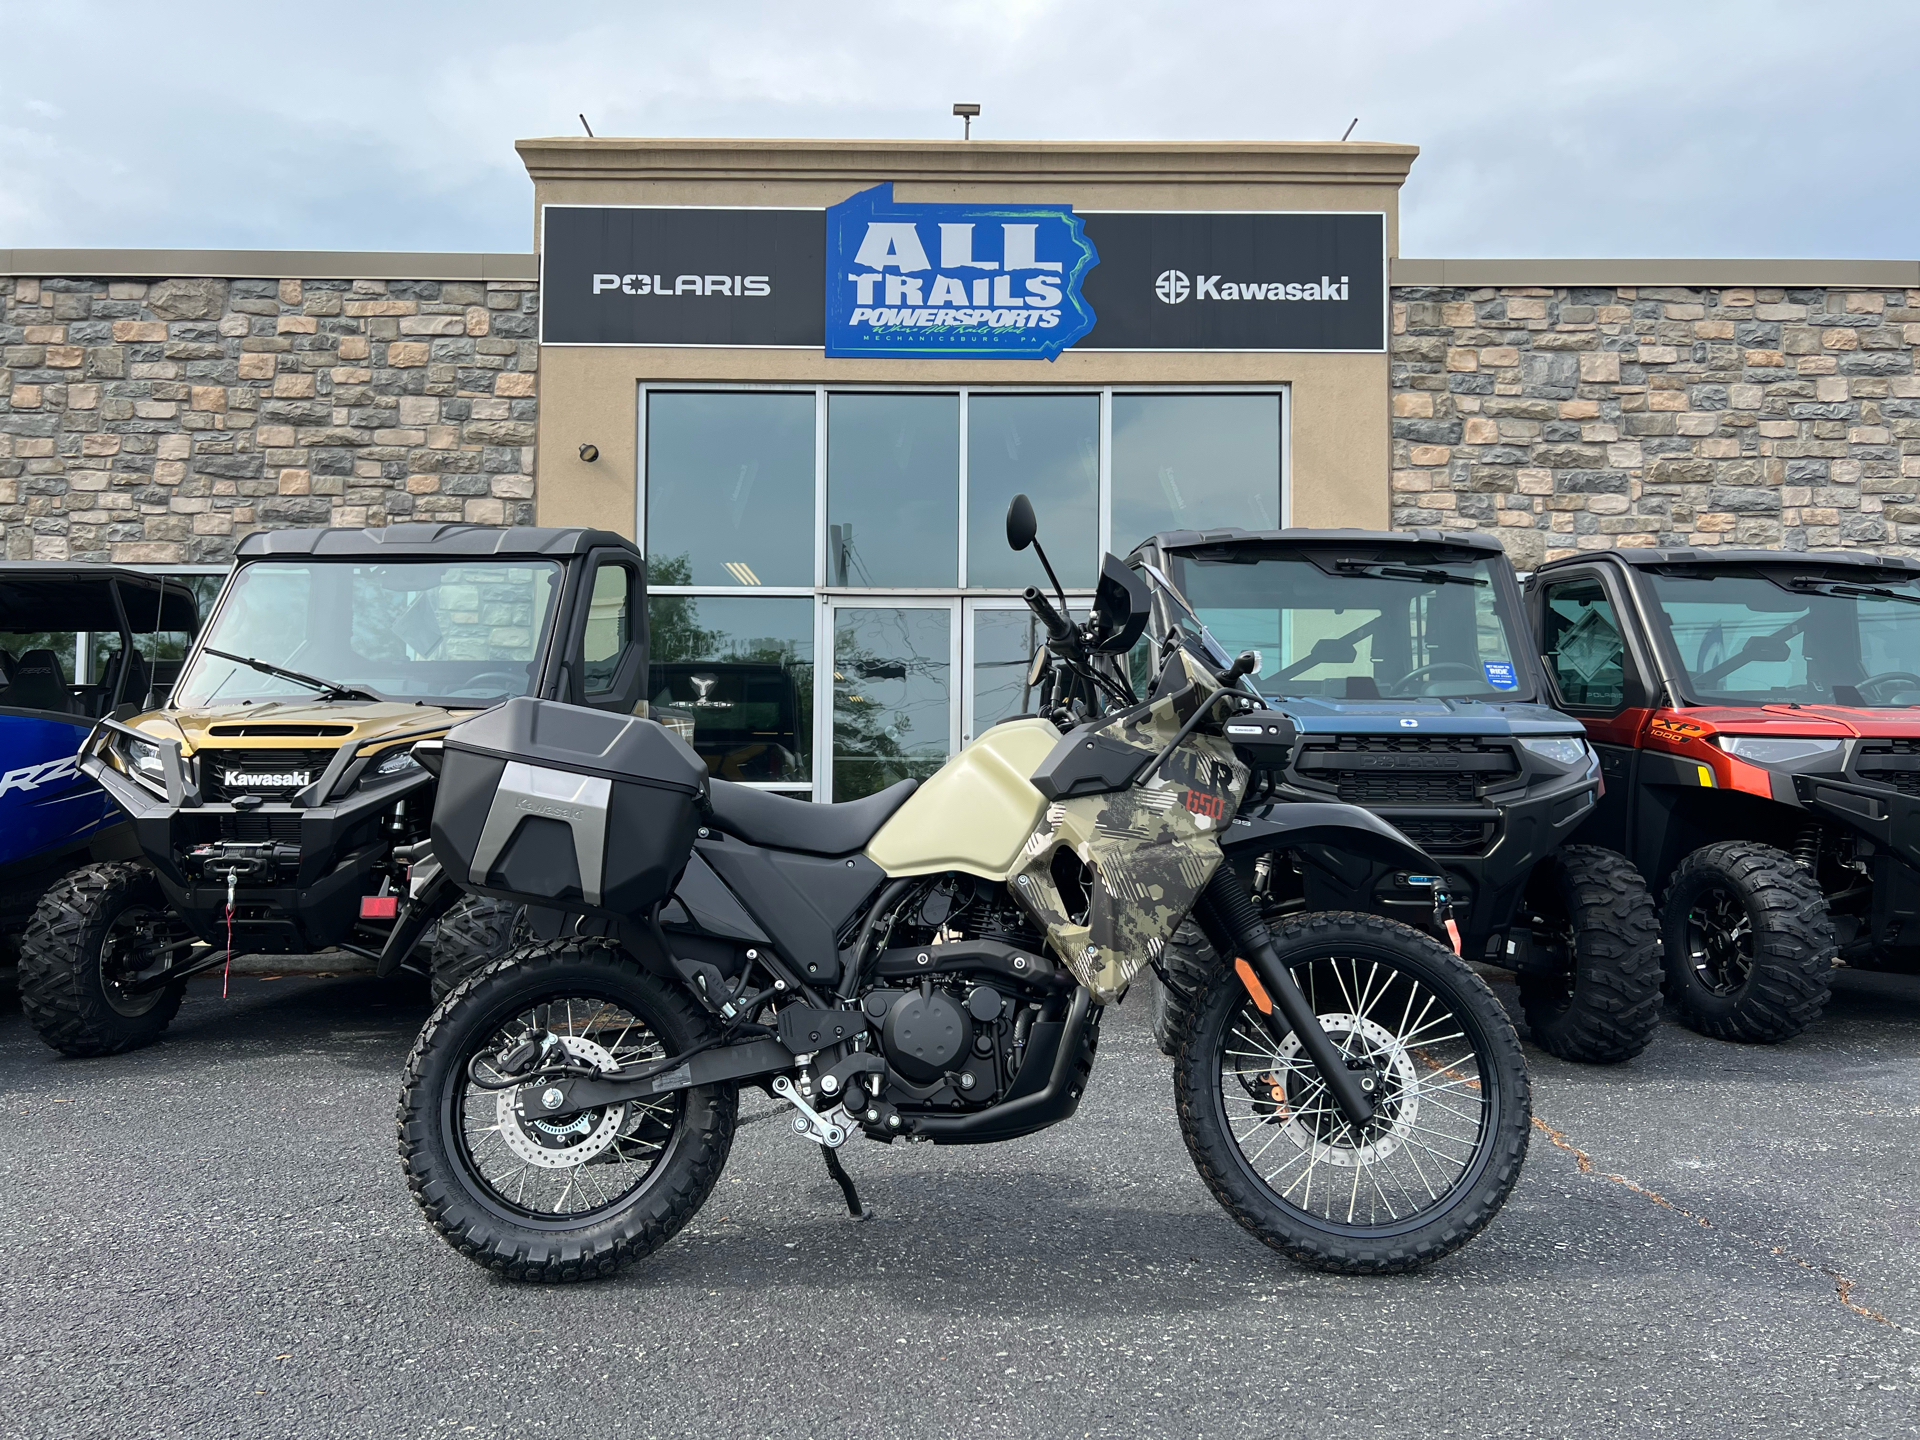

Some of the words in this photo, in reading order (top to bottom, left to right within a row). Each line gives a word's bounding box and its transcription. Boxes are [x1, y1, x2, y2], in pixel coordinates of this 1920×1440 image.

[854, 222, 1063, 274] ALL
[592, 273, 771, 297] POLARIS
[848, 273, 1063, 308] TRAILS
[1196, 275, 1349, 301] Kawasaki
[849, 308, 1061, 328] POWERSPORTS
[1650, 729, 1683, 742] 1000
[1655, 718, 1701, 732] XP
[1360, 755, 1460, 769] POLARIS
[0, 755, 82, 798] RZ
[224, 771, 310, 786] Kawasaki
[514, 797, 584, 821] Kawasaki
[1185, 789, 1224, 820] 650
